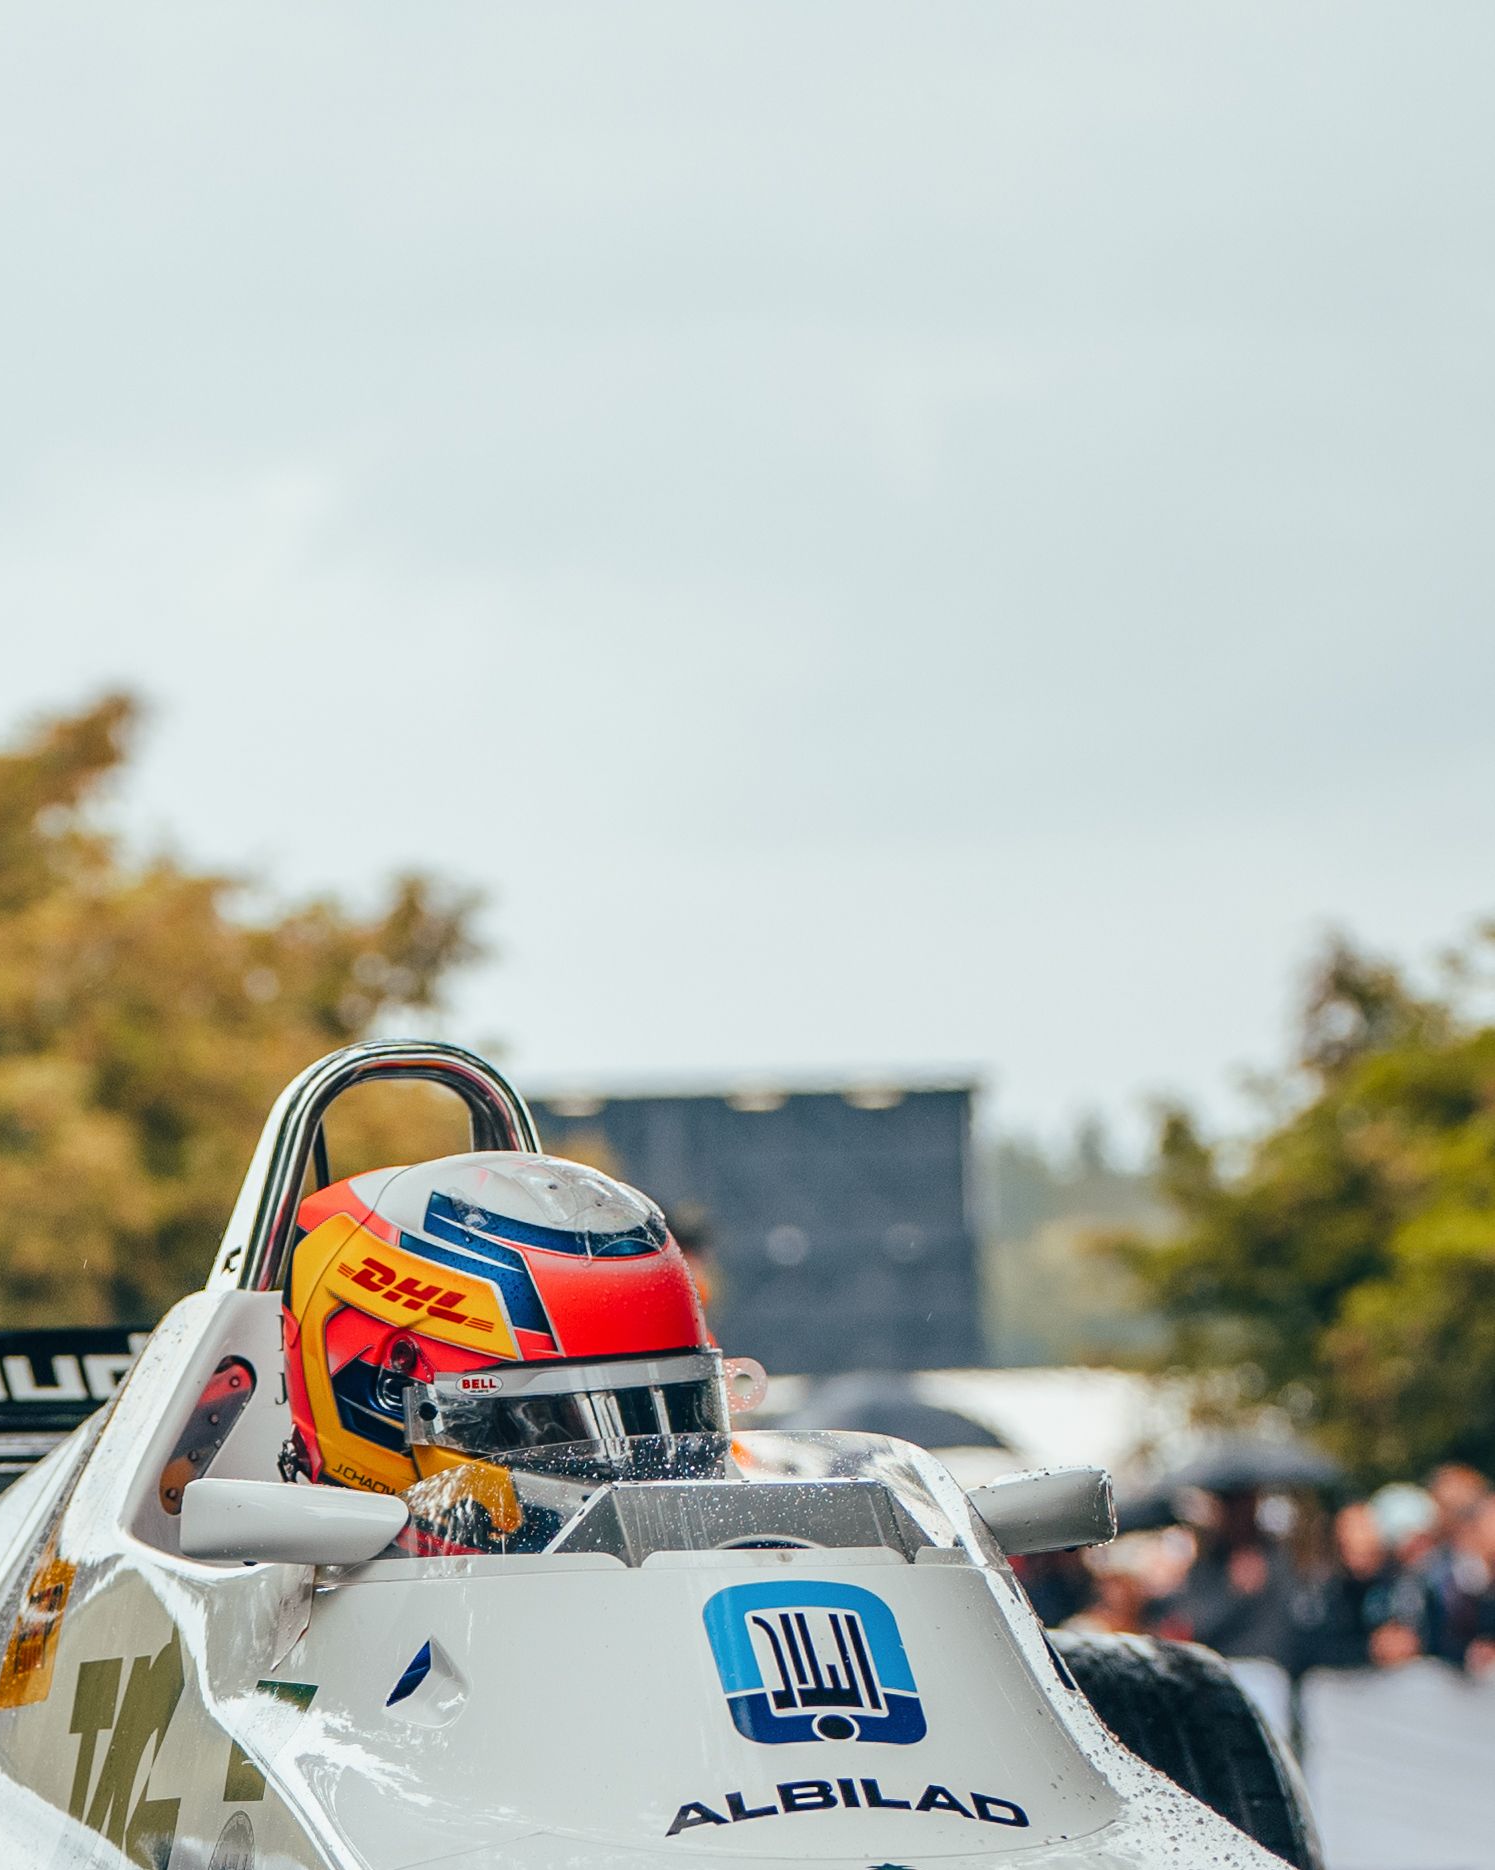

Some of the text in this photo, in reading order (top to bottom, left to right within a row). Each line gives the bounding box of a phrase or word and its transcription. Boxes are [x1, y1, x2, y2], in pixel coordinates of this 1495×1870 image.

[351, 1257, 468, 1324] DHL
[462, 1379, 497, 1389] BELL
[665, 1778, 1030, 1837] ALBILAD
